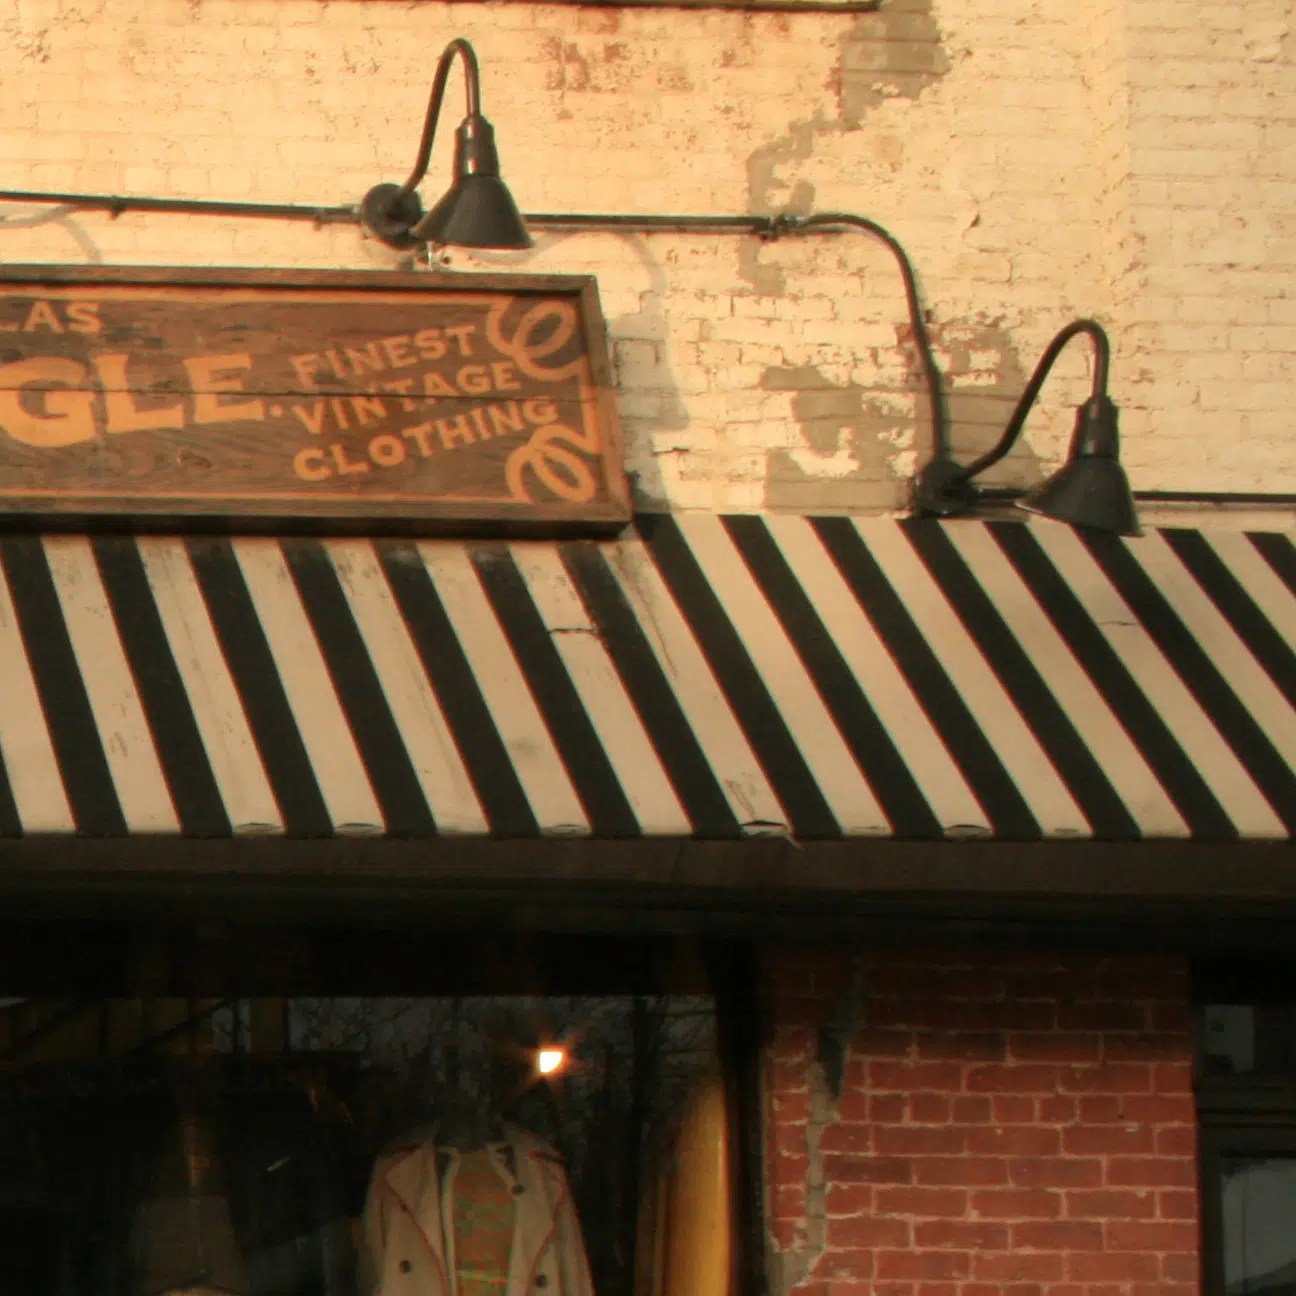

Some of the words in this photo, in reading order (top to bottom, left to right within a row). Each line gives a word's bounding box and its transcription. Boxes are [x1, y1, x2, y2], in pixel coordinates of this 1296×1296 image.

[290, 325, 476, 390] FINEST
[292, 360, 521, 435] VINTAGE
[293, 396, 558, 482] CLOTHING
